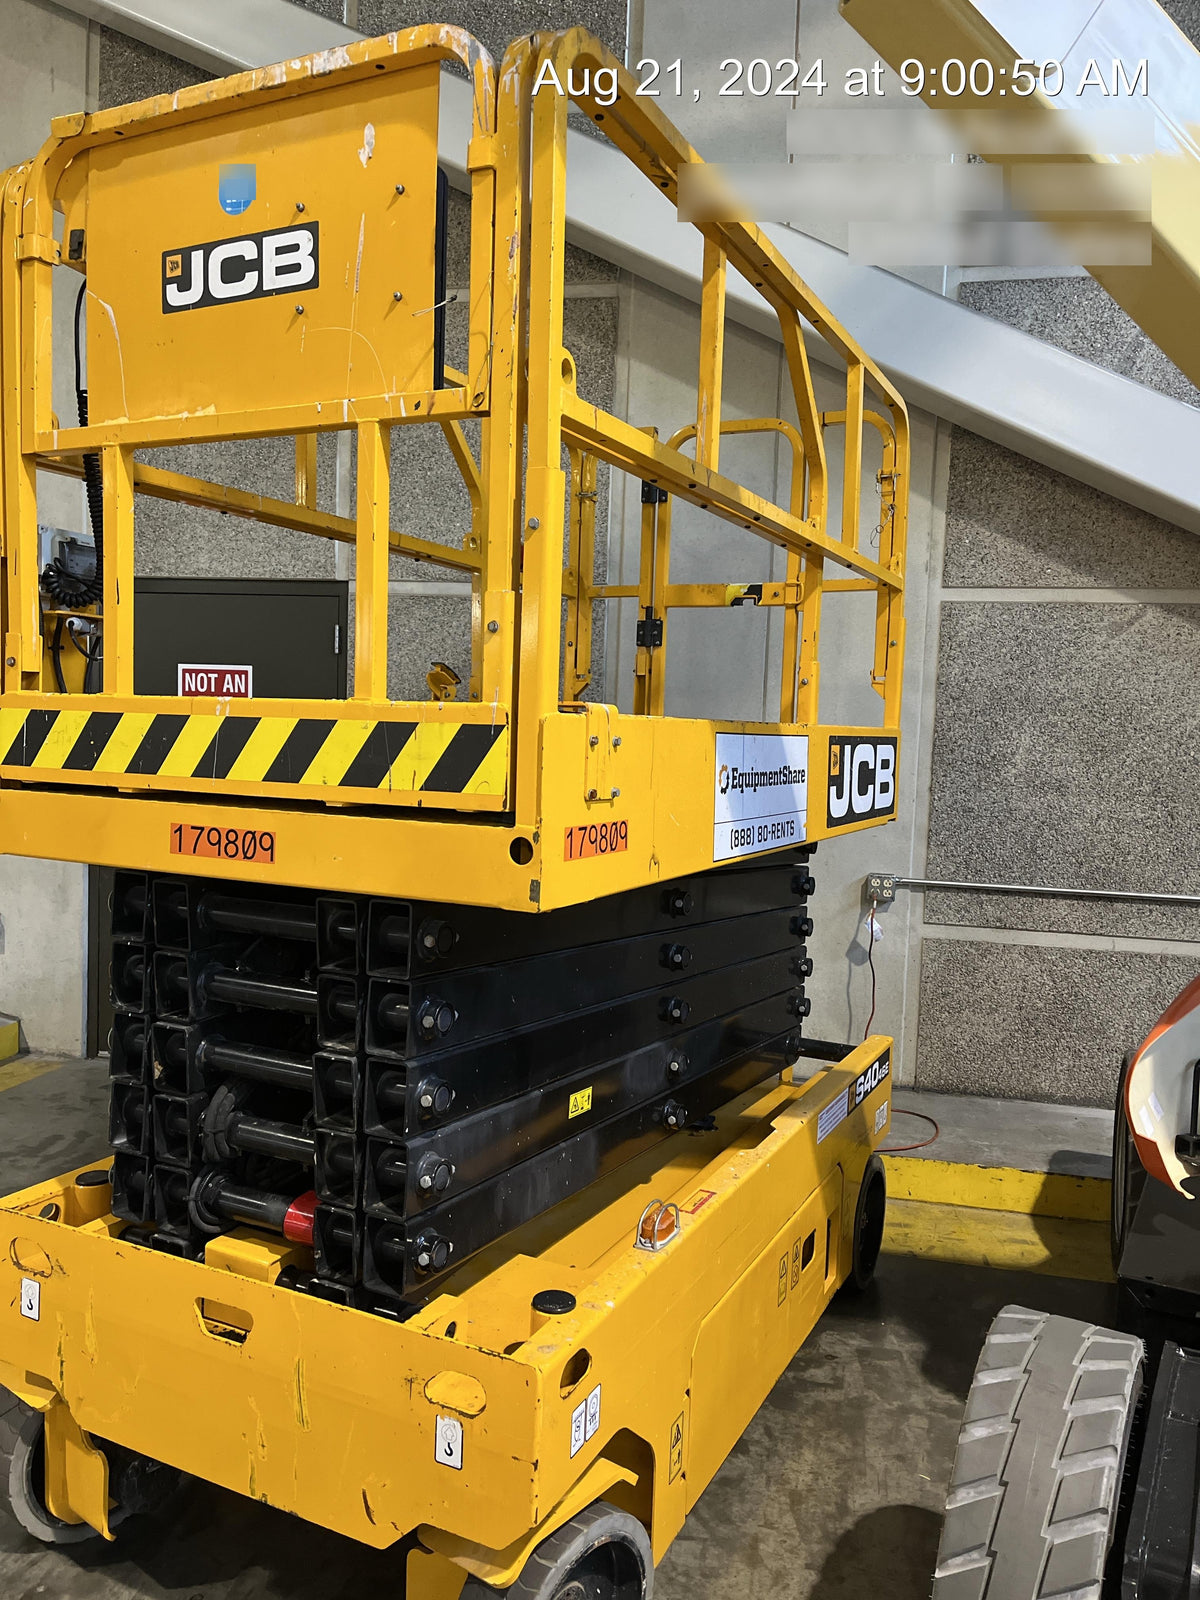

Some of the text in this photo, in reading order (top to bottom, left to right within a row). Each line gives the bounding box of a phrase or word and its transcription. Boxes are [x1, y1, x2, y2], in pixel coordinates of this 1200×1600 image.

[165, 229, 316, 307] JCB
[184, 672, 246, 694] NOT AN
[730, 765, 806, 794] EquipmentShare
[829, 743, 896, 819] JCB
[173, 824, 276, 863] 179809
[566, 820, 628, 859] 179809
[730, 820, 796, 850] (888) 80-RENTS
